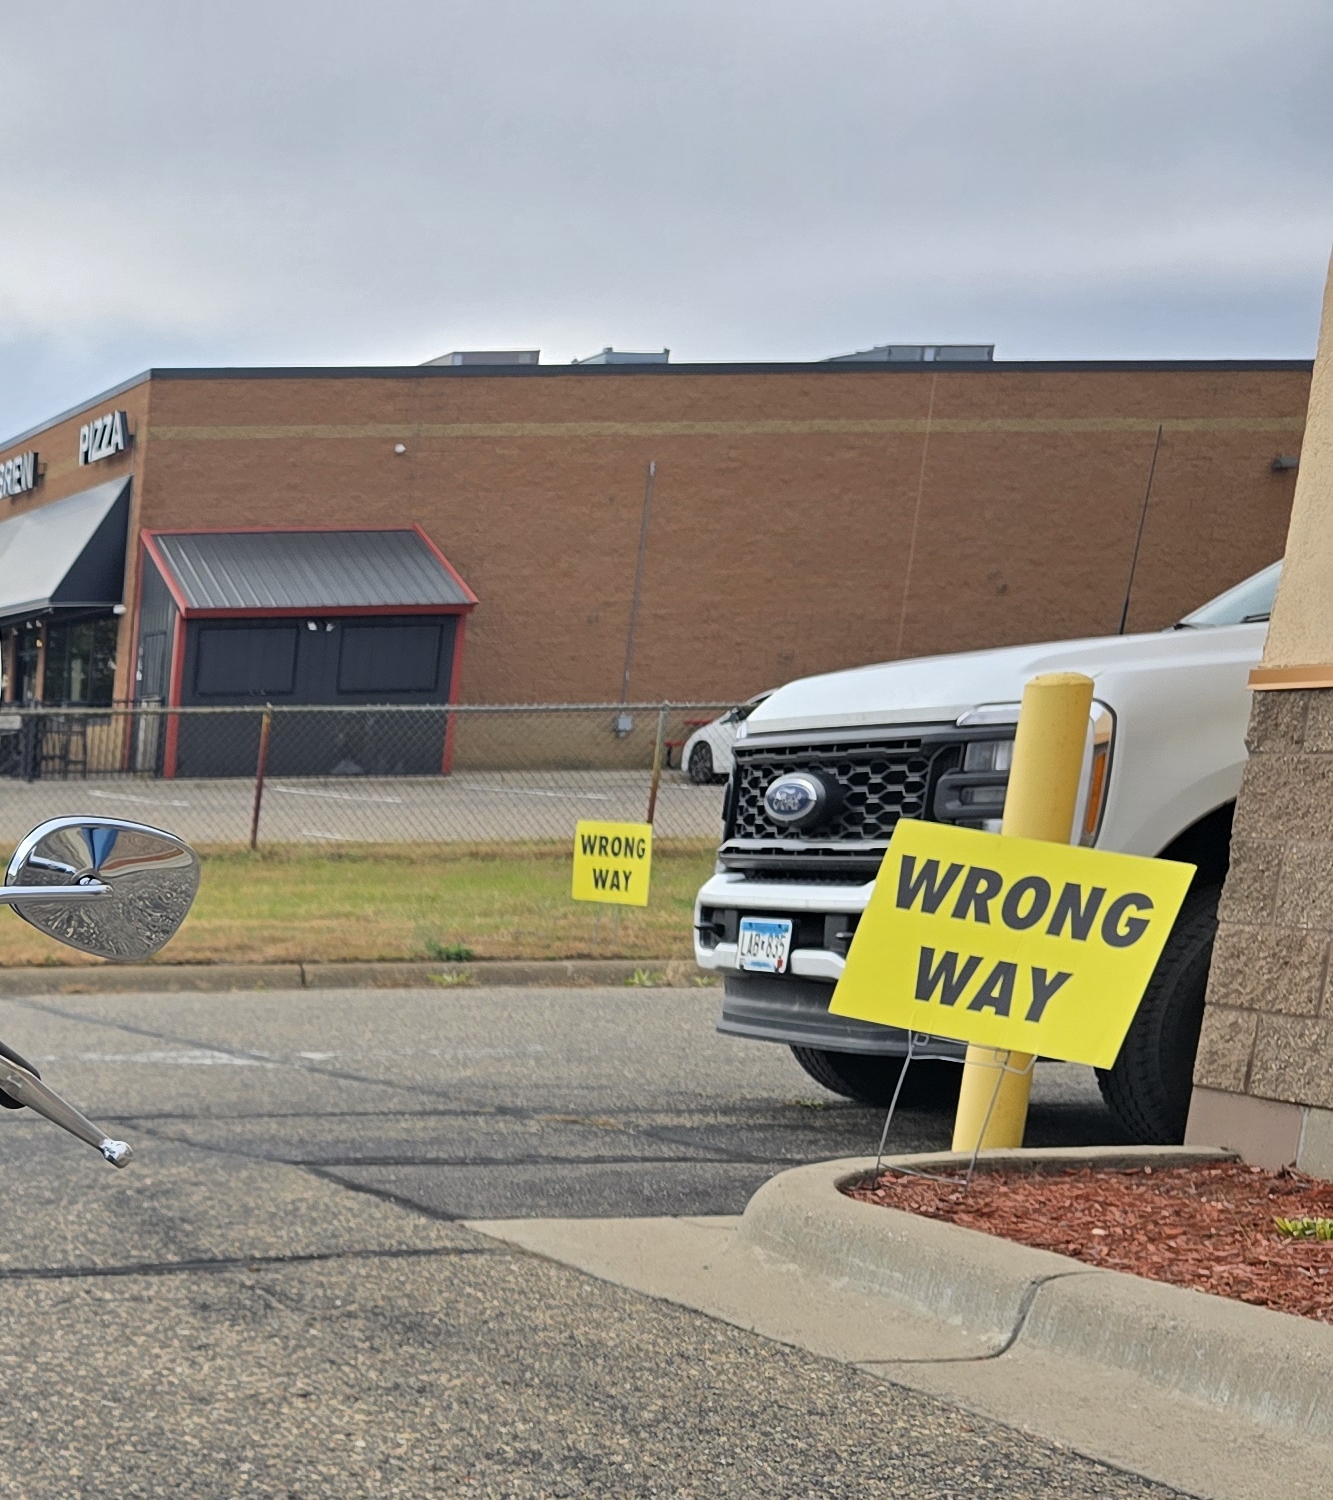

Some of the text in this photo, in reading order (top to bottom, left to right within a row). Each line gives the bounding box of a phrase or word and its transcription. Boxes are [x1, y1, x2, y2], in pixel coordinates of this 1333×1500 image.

[79, 410, 126, 466] PIZZA
[580, 834, 646, 859] WRONG
[592, 868, 633, 892] WAY
[895, 854, 1155, 948] WRONG
[914, 945, 1074, 1024] WAY
